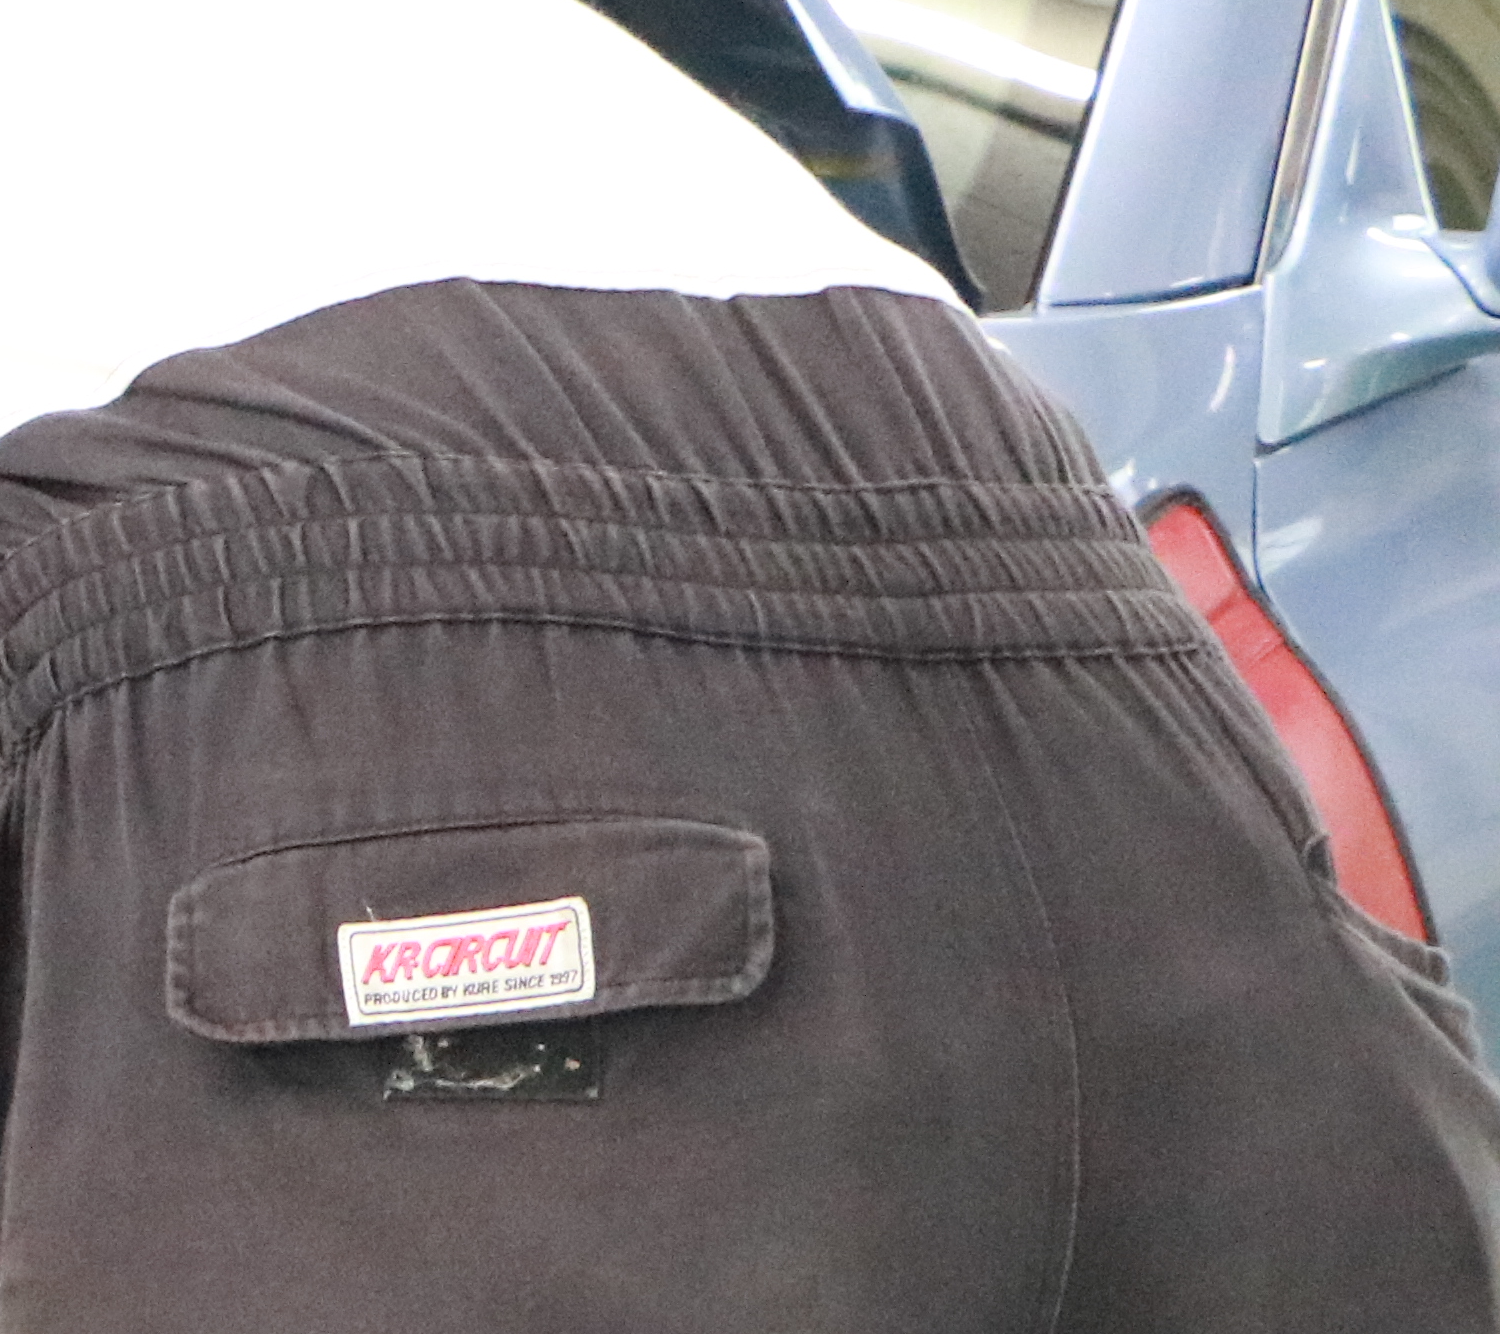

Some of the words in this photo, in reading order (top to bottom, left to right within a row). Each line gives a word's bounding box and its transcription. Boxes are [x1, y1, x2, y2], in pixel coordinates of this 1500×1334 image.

[363, 986, 439, 1006] PRODUCED
[440, 984, 458, 999] BY
[504, 974, 545, 992] SINCE
